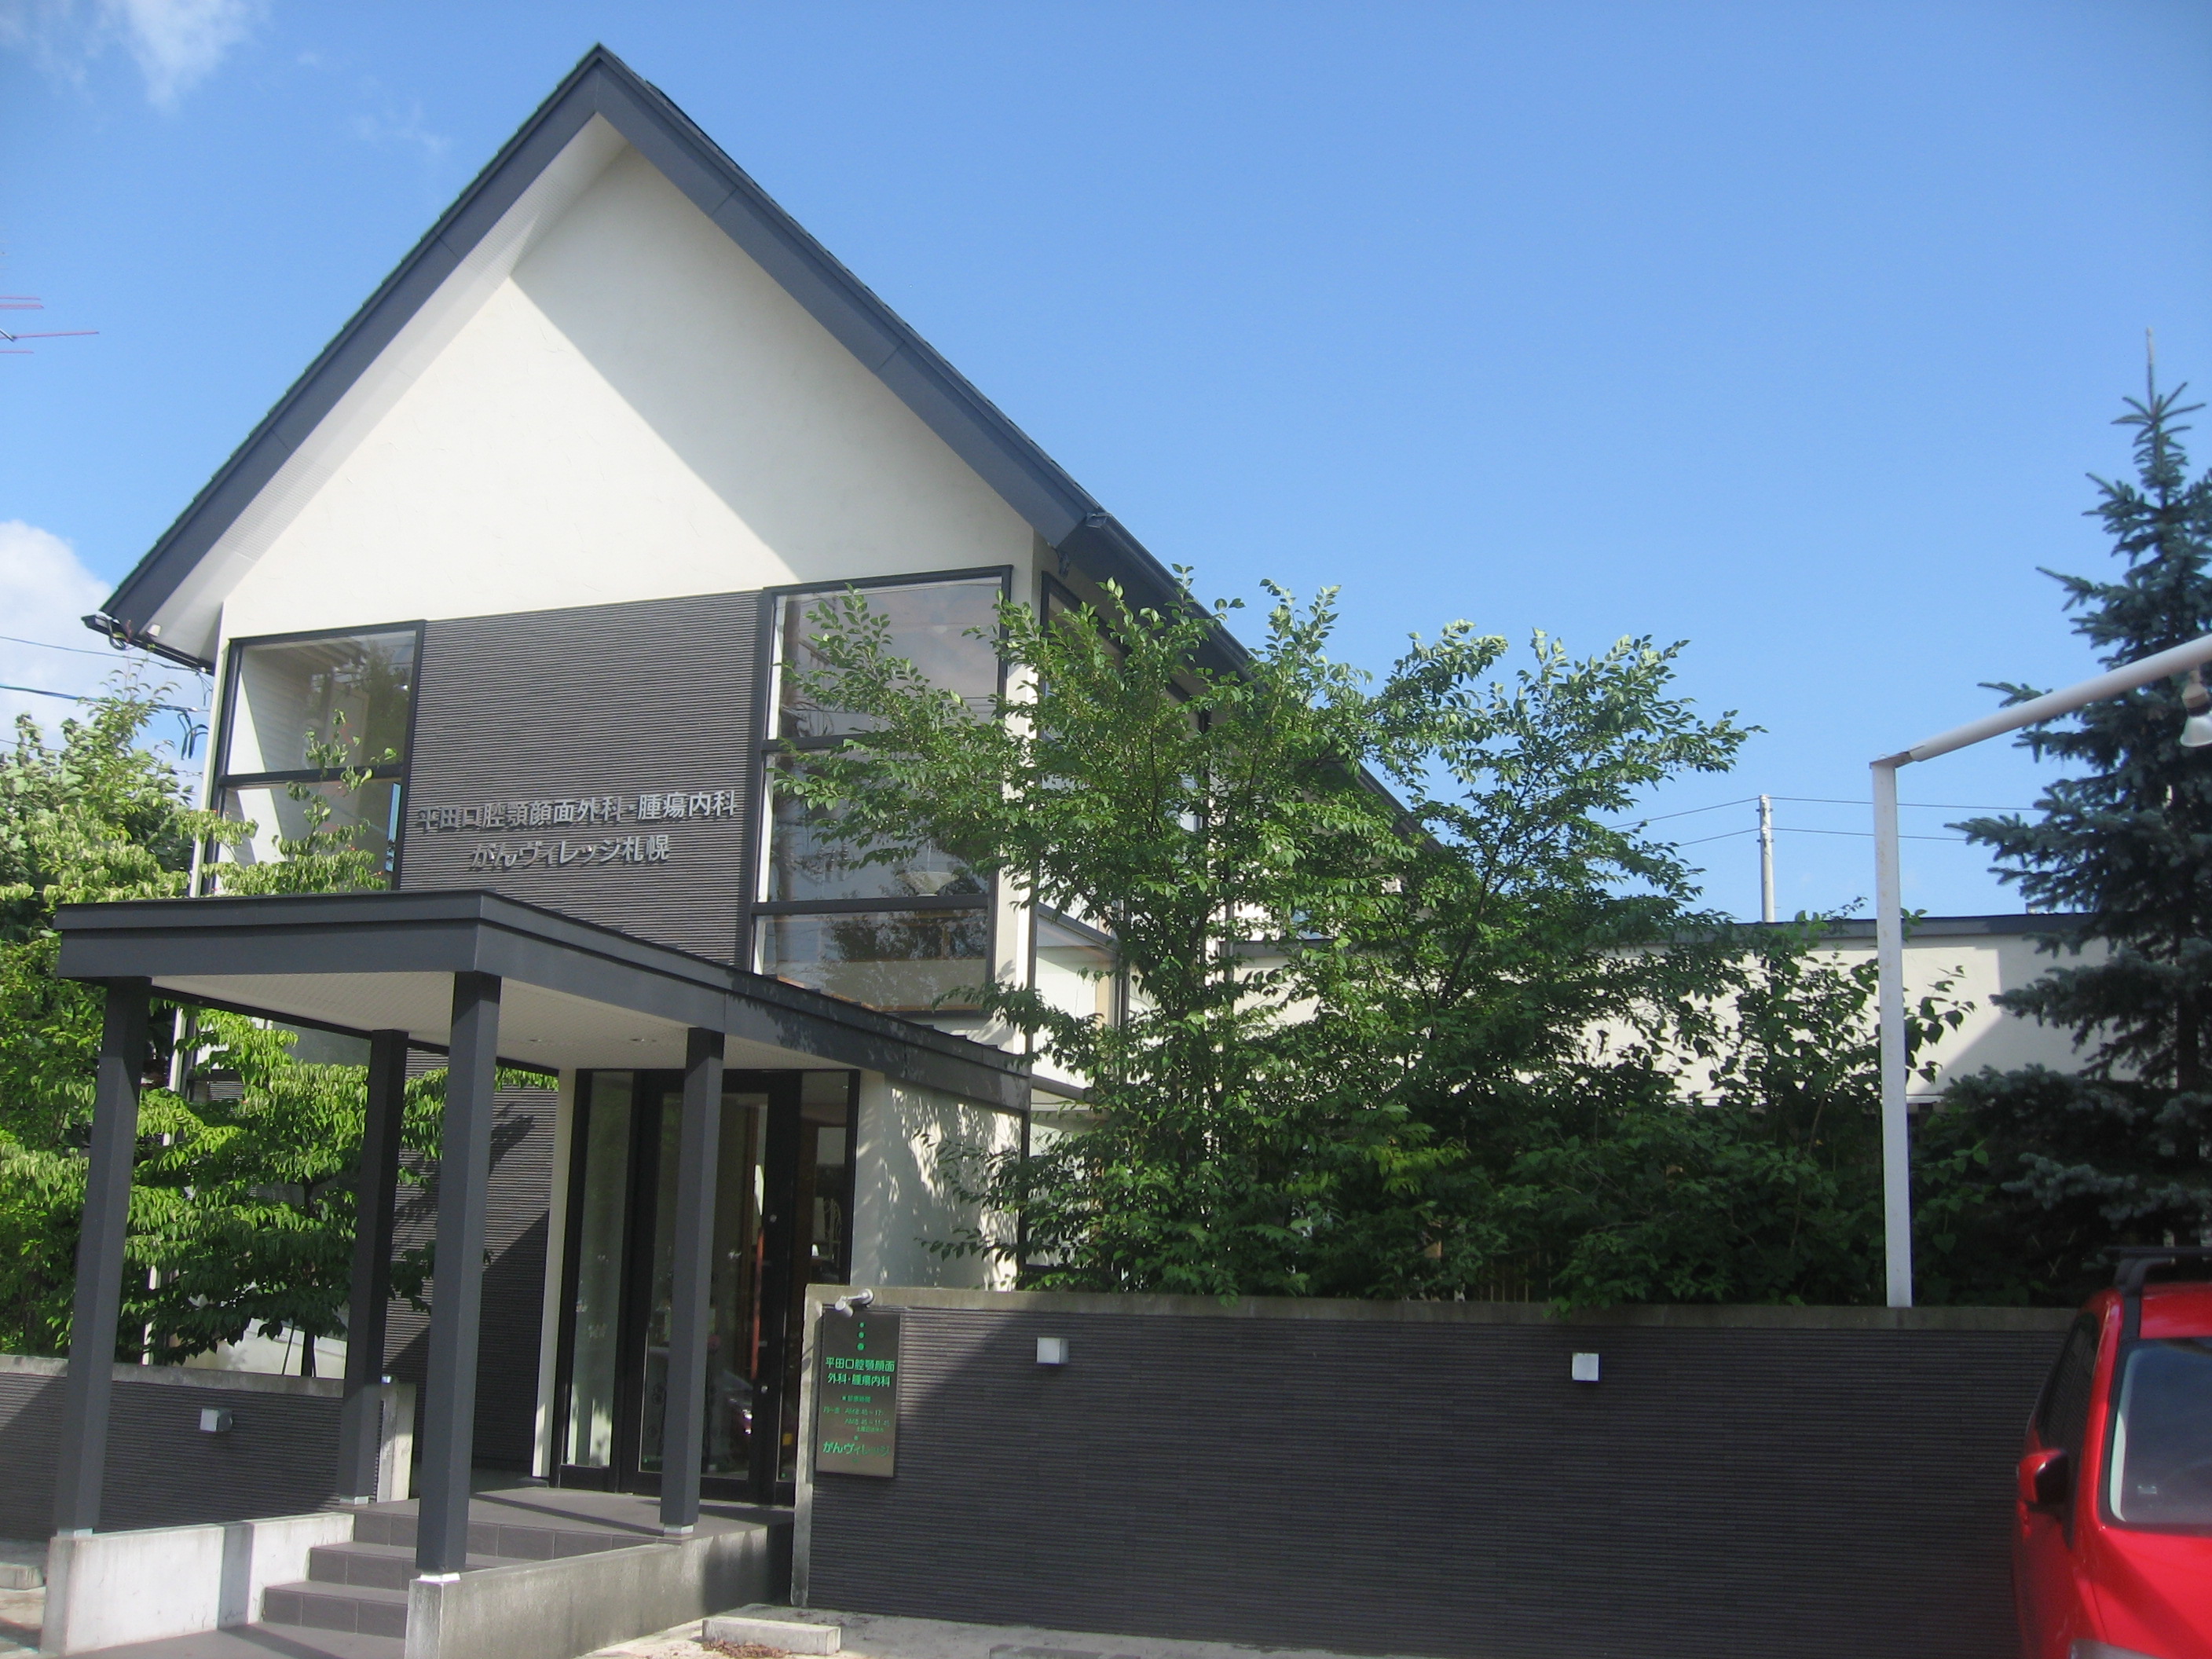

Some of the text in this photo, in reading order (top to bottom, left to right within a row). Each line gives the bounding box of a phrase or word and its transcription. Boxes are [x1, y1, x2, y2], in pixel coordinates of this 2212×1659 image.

[471, 834, 669, 867] がんヴィレッジ札幌
